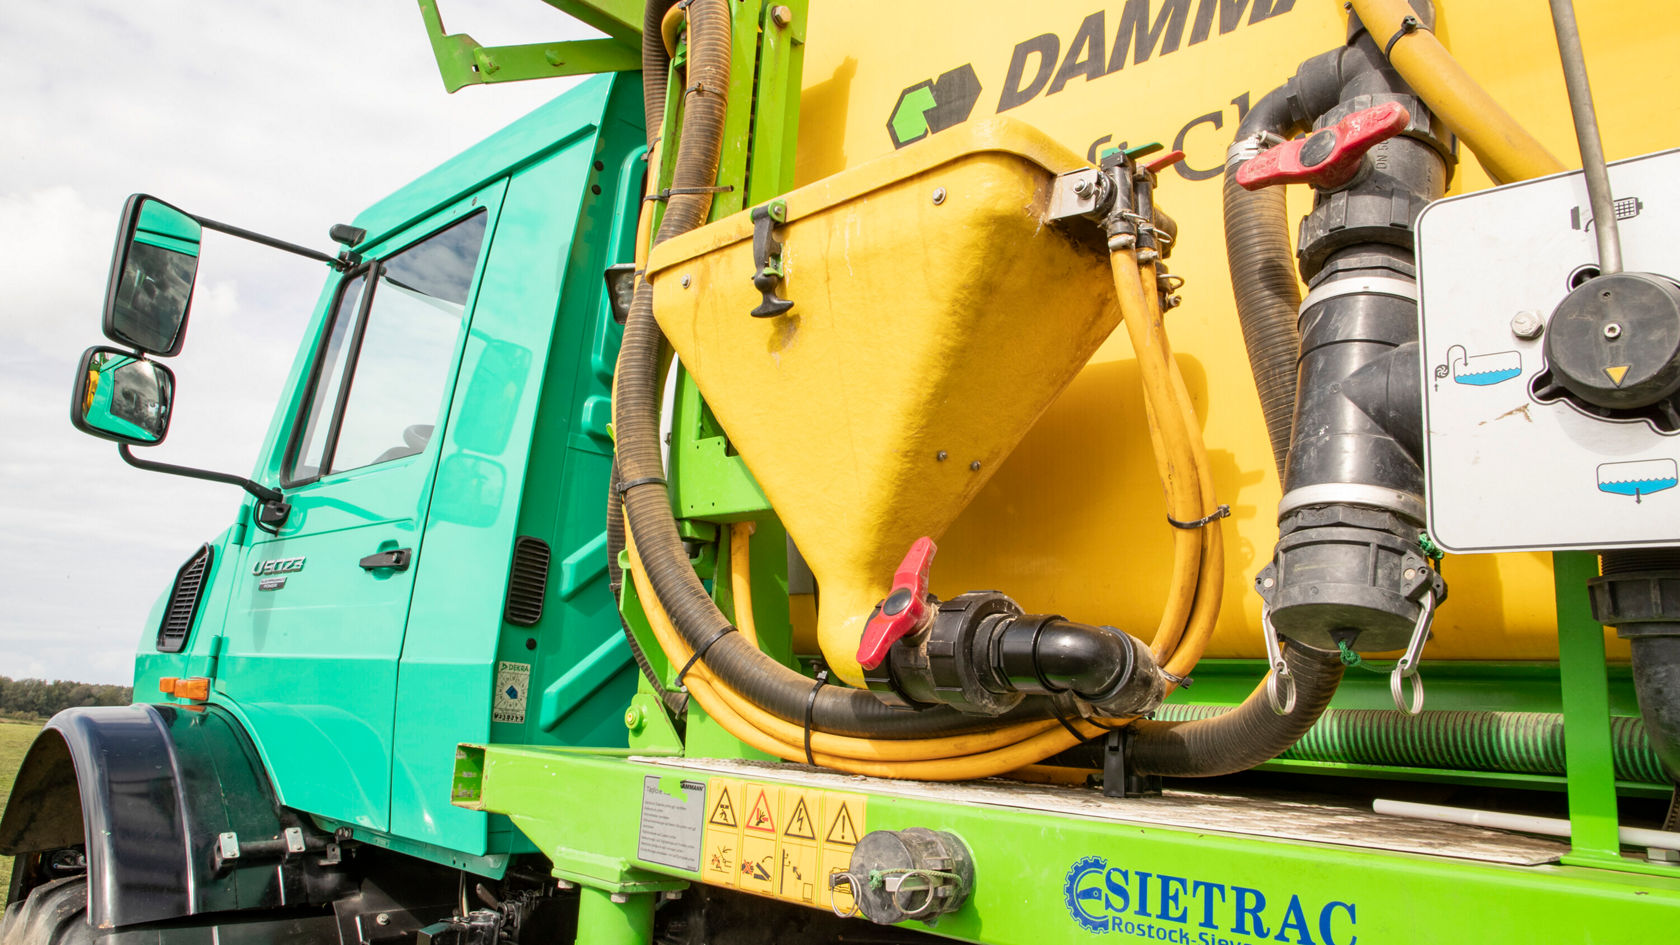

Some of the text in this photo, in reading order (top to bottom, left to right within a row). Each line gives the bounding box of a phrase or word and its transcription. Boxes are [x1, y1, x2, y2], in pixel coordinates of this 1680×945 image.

[996, 0, 1295, 114] DAMM
[252, 557, 306, 575] U5023
[508, 664, 529, 672] DEKRA
[680, 783, 704, 792] AMMANN
[1104, 866, 1358, 945] SIETRAC
